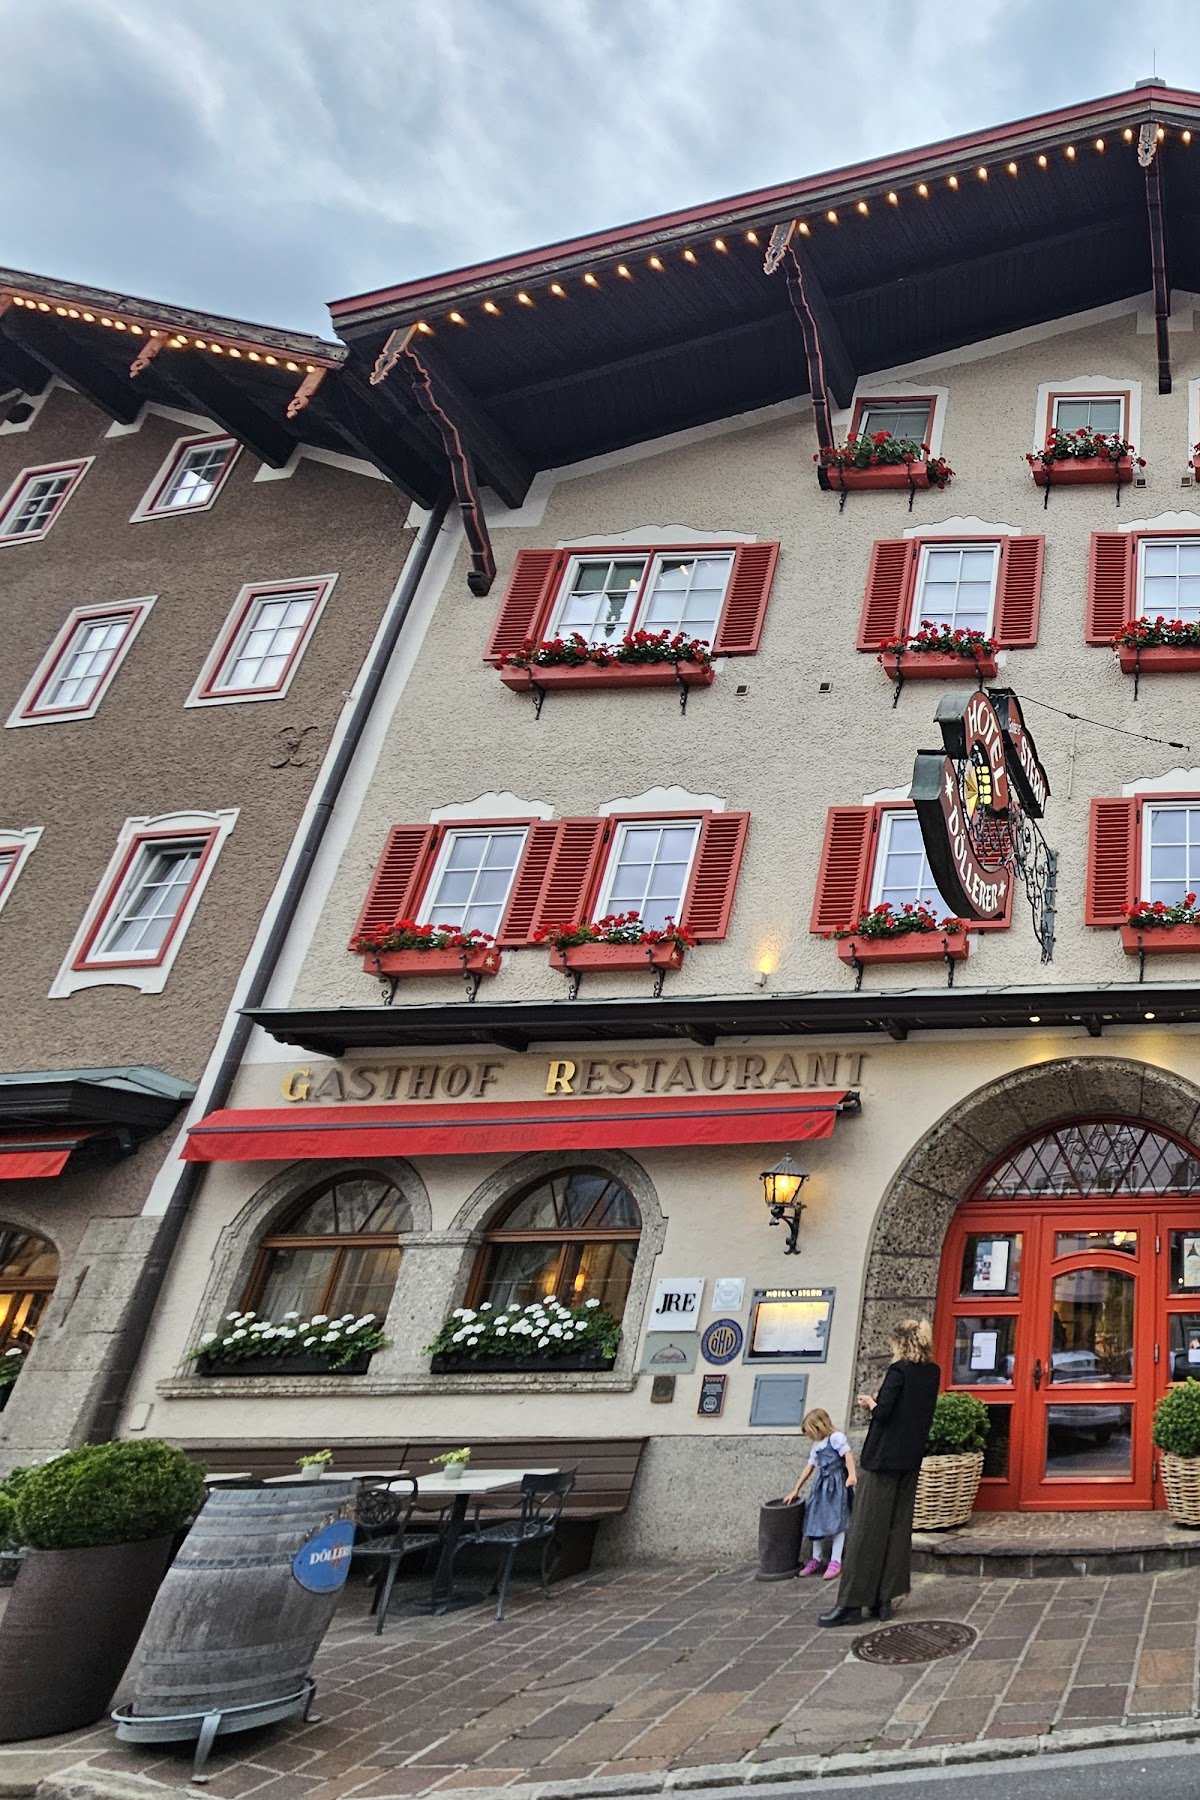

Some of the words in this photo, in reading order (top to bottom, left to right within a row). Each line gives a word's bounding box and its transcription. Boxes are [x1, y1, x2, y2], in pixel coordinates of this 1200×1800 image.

[967, 700, 1004, 797] HOTEL
[1020, 736, 1046, 814] STERN
[947, 804, 999, 912] DÖLLERER
[281, 1062, 504, 1101] GASTHOF
[543, 1051, 873, 1096] RESTAURANT
[656, 1293, 697, 1315] JRE
